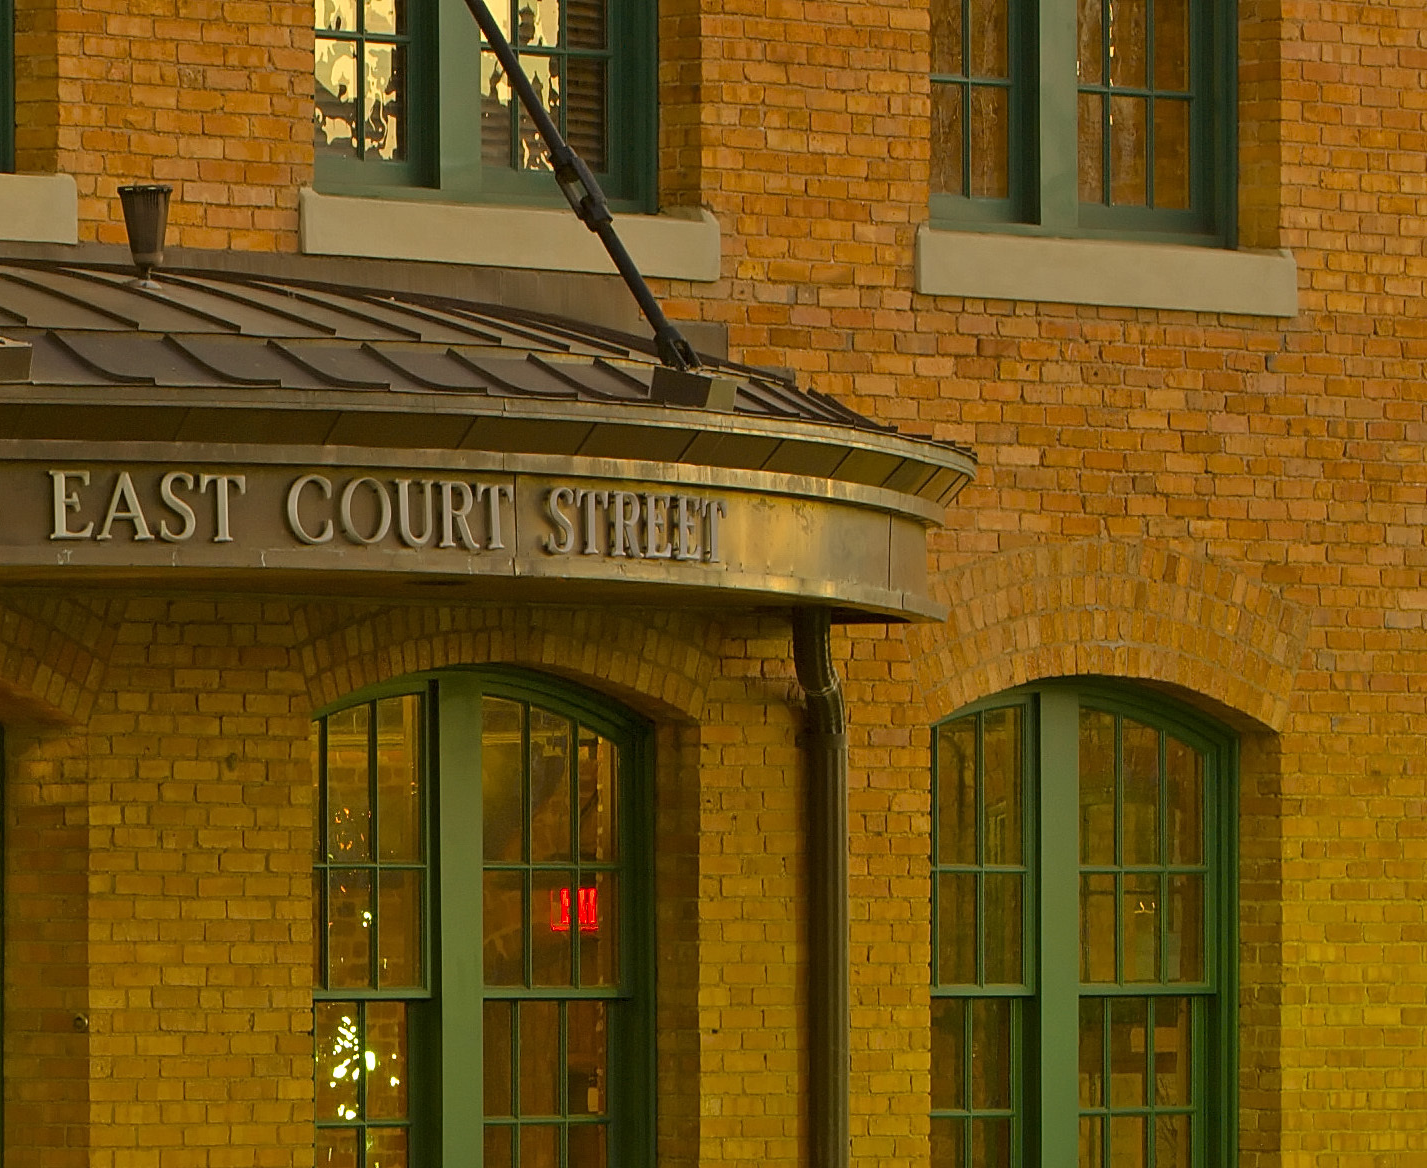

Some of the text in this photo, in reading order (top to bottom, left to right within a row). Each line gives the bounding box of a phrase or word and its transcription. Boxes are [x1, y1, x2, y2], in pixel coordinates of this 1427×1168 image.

[48, 469, 246, 543] EAST
[286, 474, 514, 552] COURT
[542, 486, 728, 564] STREET
